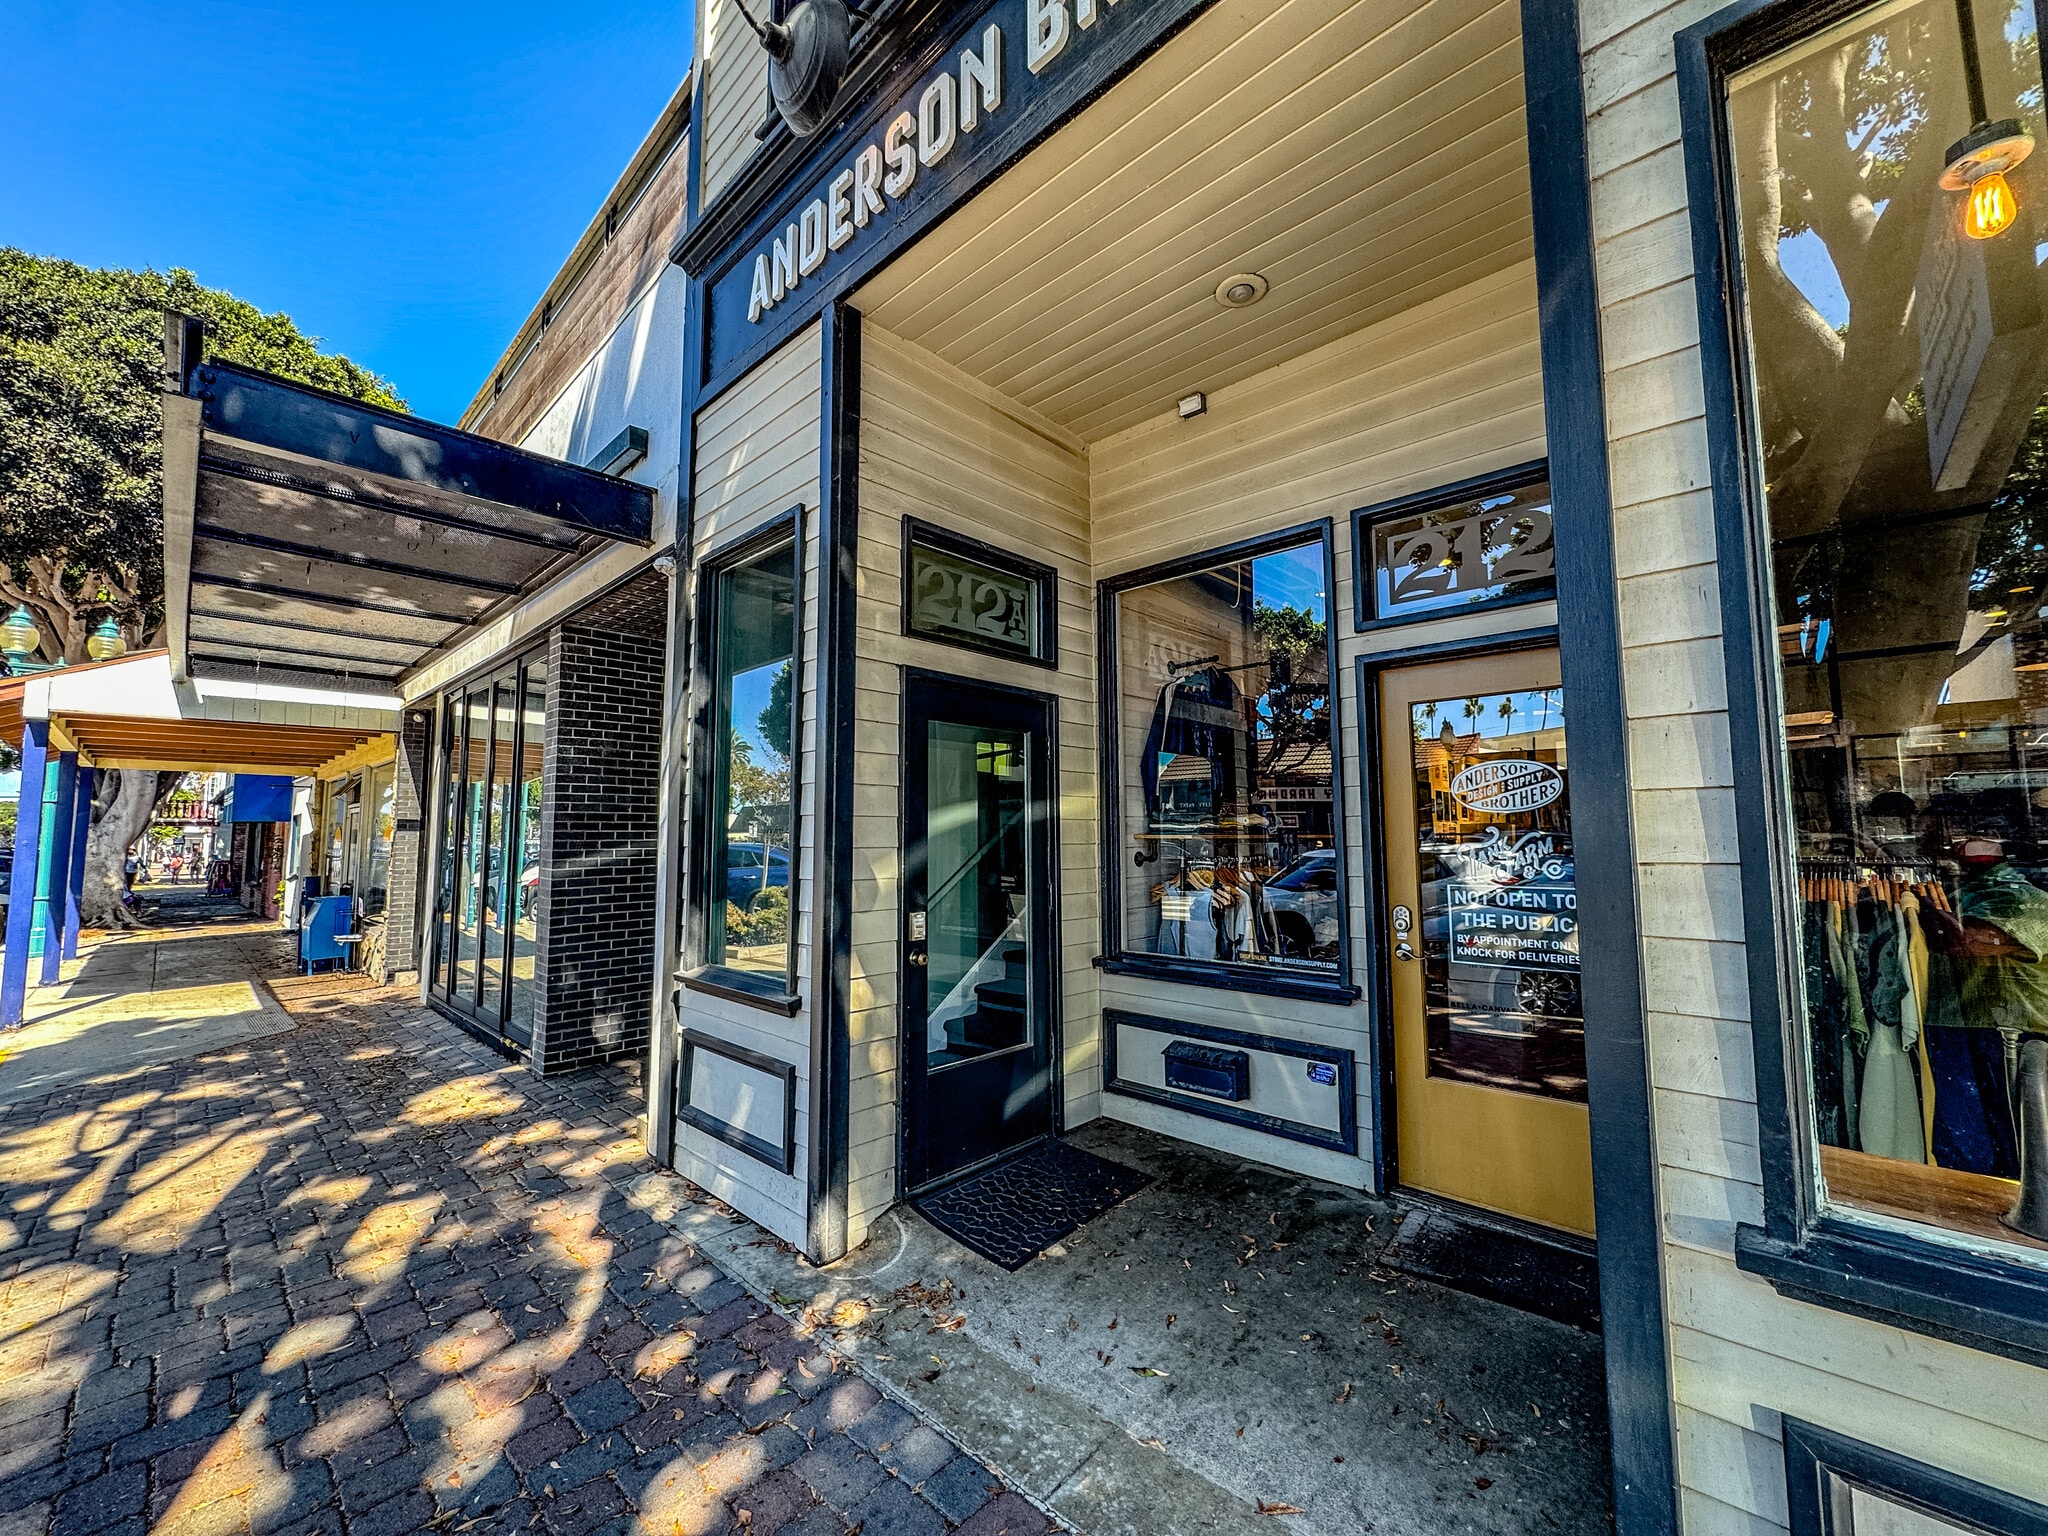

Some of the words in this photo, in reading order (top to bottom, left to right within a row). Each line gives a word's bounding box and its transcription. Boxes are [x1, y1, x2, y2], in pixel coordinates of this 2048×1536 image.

[747, 23, 1001, 323] ANDERSON
[1392, 506, 1553, 601] 212
[1456, 764, 1528, 792] ANDERSON
[1466, 784, 1499, 803] DESIGN
[1507, 771, 1543, 790] SUPPLY
[1481, 782, 1557, 808] BROTHERS
[1523, 865, 1536, 880] &
[1454, 890, 1488, 905] NOT
[1496, 892, 1547, 909] OPEN
[1552, 893, 1577, 909] TO
[1461, 912, 1496, 928] THE
[1502, 915, 1574, 933] PUBLIC
[1457, 934, 1471, 943] BY
[1473, 935, 1549, 949] APPOINTMENT
[1551, 940, 1580, 951] ONLY
[1457, 946, 1492, 958] KNOCK
[1495, 950, 1516, 960] FOR
[1518, 952, 1580, 965] DELIVERIES
